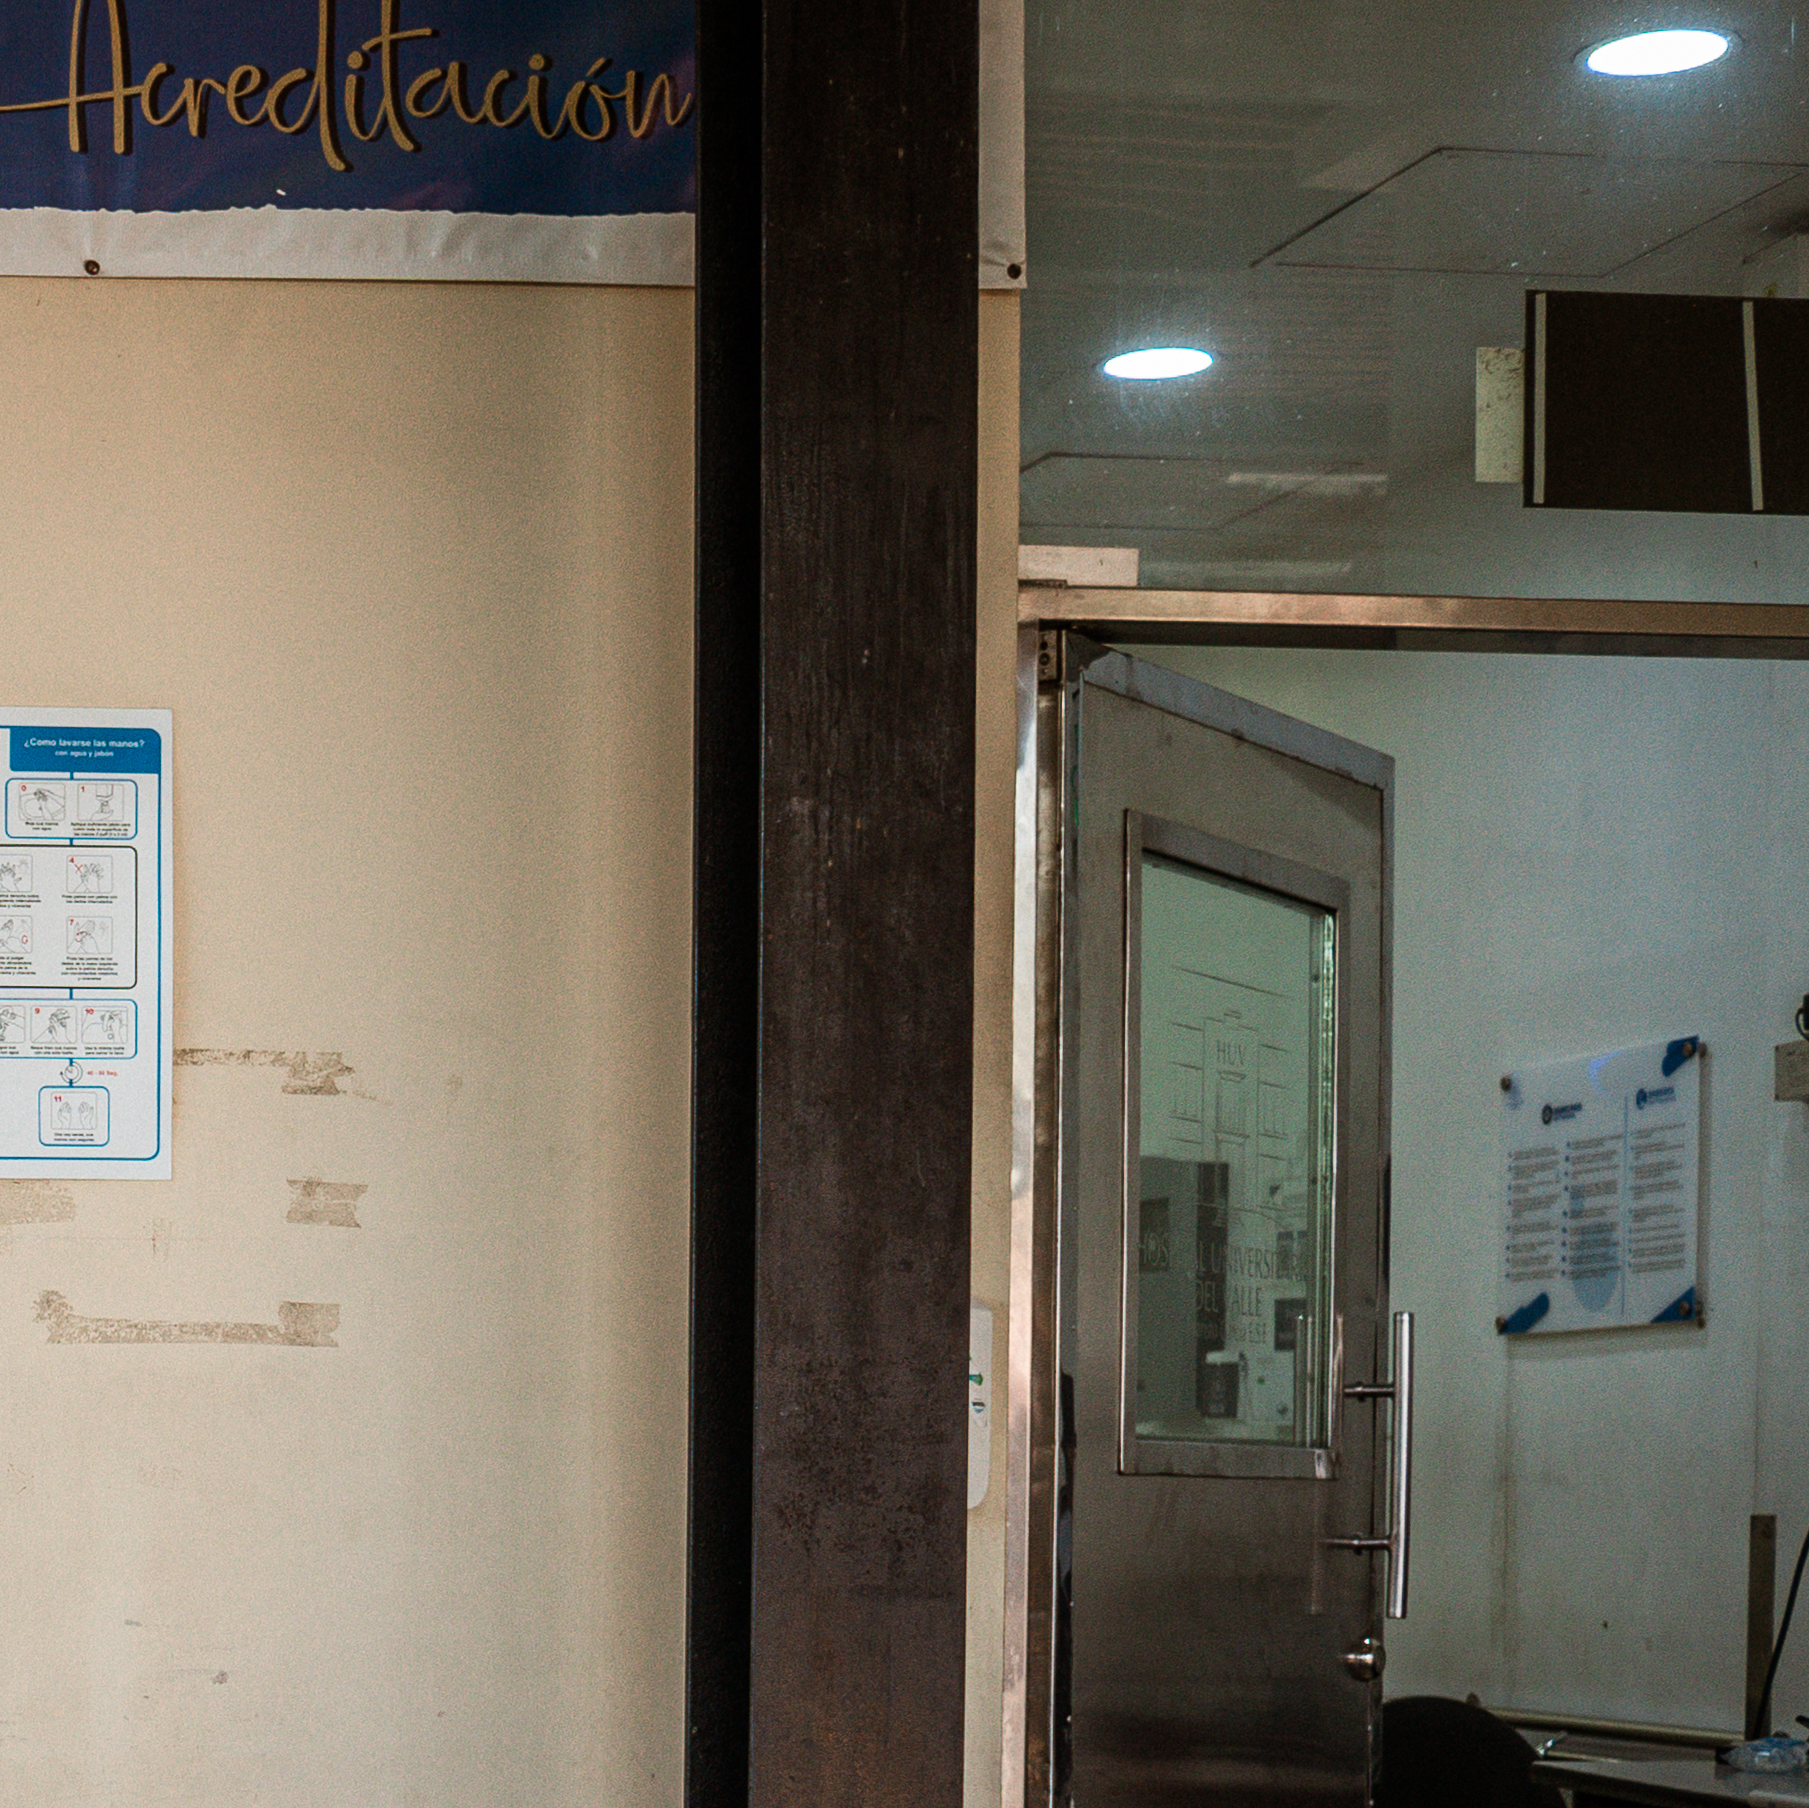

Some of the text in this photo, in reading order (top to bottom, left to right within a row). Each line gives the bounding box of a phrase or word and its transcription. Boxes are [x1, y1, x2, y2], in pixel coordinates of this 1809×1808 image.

[68, 0, 692, 170] Acreditación
[59, 739, 92, 747] lavarse
[93, 739, 107, 747] las
[108, 740, 146, 748] manos?
